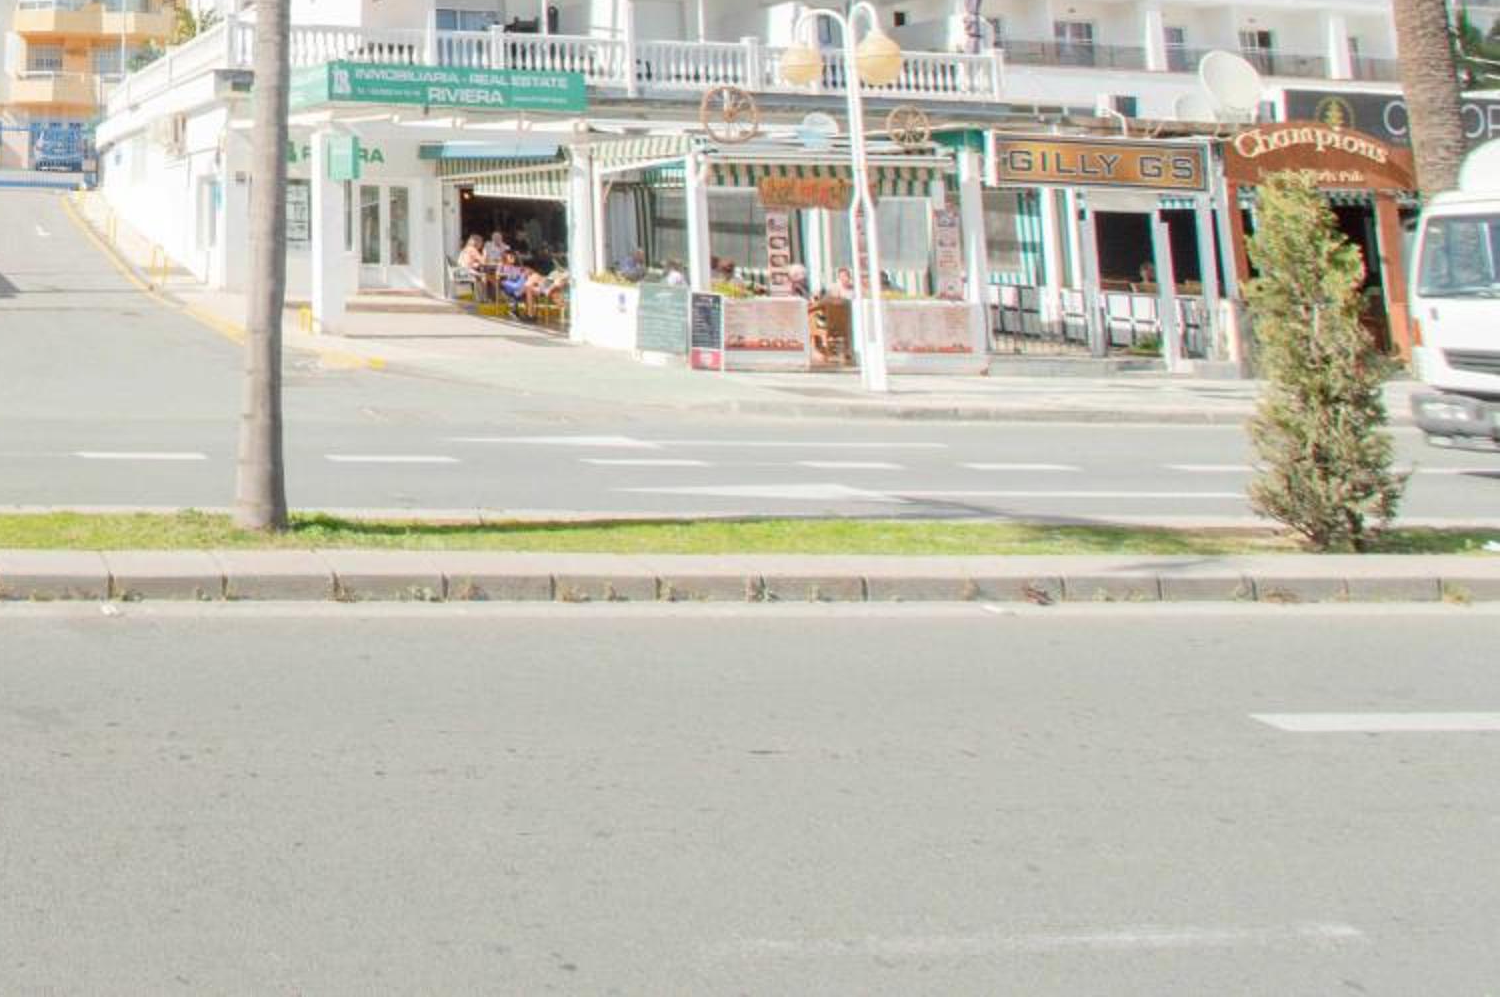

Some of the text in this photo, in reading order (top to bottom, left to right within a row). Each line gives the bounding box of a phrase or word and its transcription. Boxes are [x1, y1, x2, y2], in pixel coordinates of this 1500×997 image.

[355, 68, 459, 84] INMOBILIARIA
[469, 74, 508, 86] REAL
[511, 76, 568, 90] ESTATE
[427, 86, 504, 104] RIVIERA
[1234, 124, 1390, 164] Champions
[1008, 150, 1119, 176] GILLY
